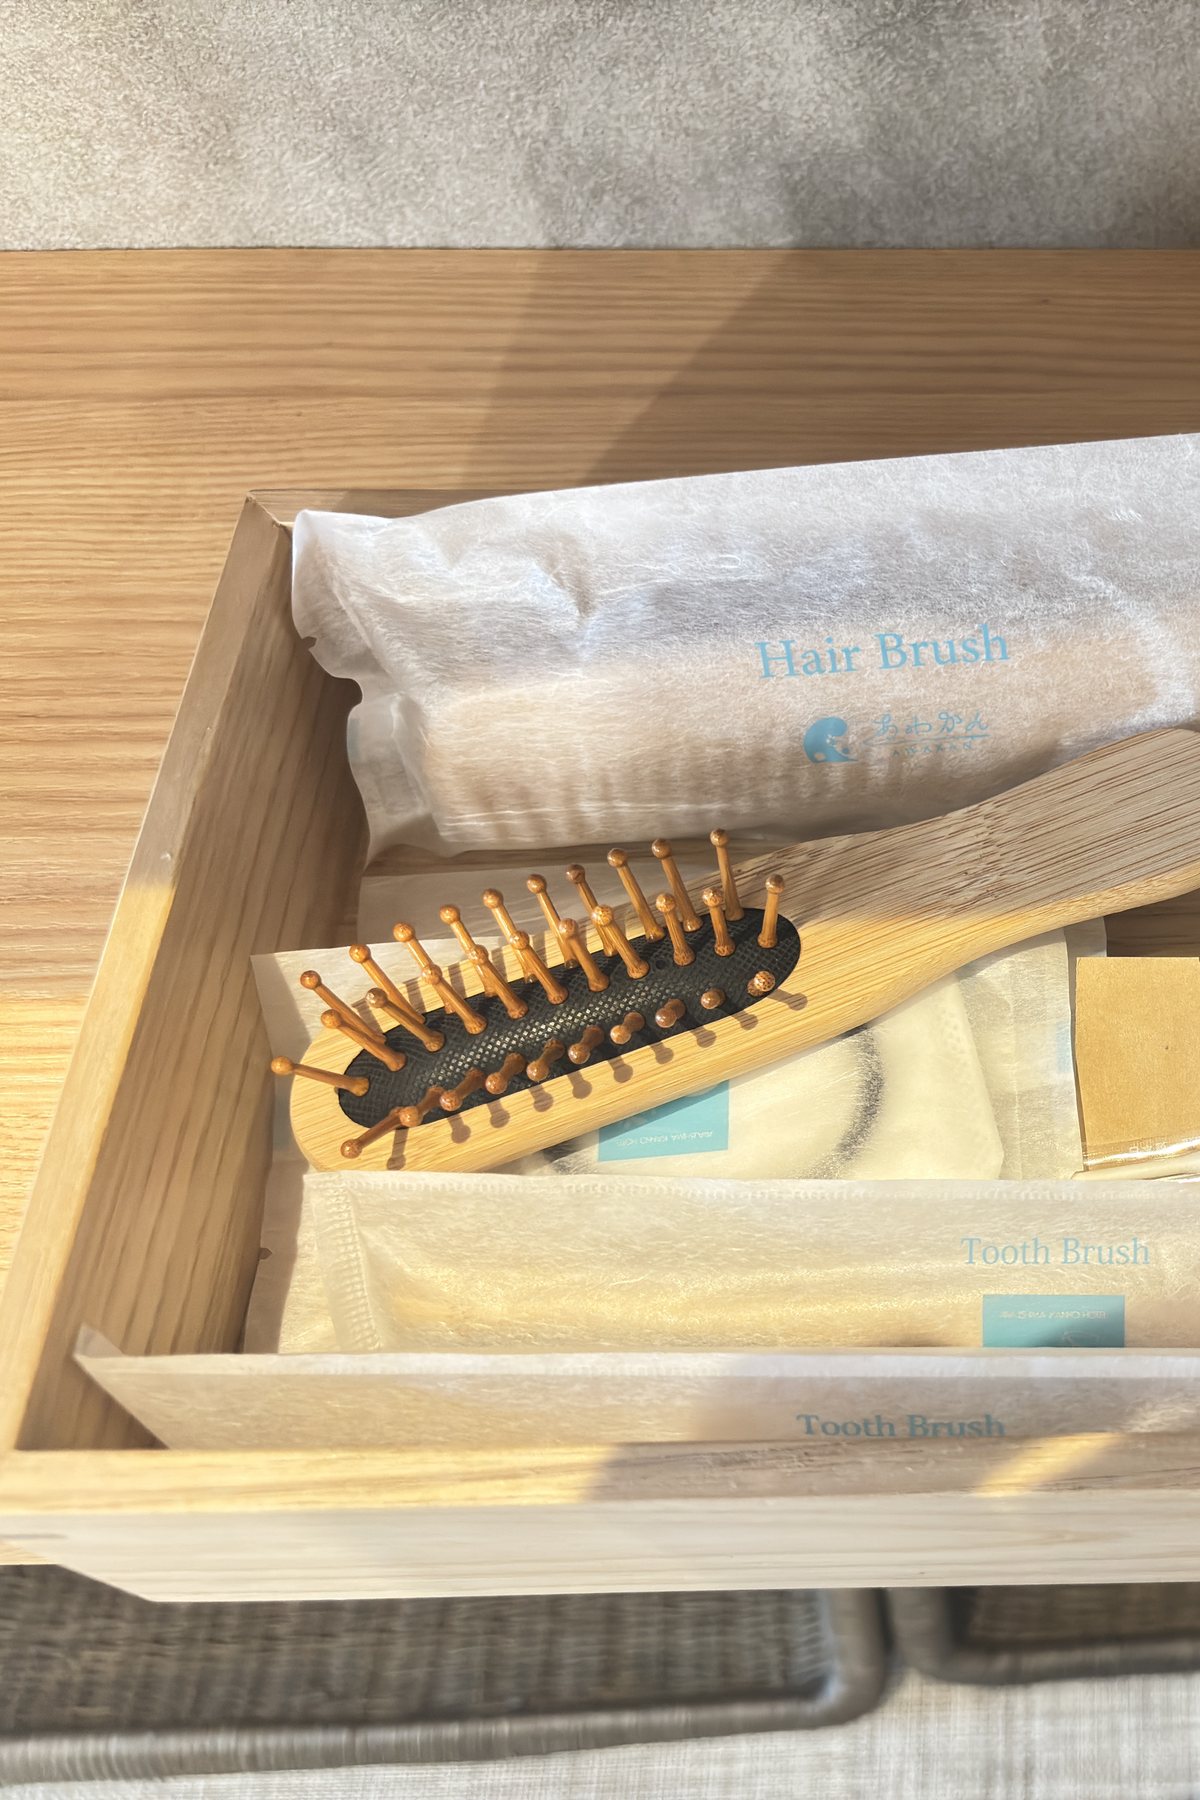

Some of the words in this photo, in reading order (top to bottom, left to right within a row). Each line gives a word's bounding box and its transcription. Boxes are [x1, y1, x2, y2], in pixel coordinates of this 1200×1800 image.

[754, 636, 861, 680] Hair
[874, 622, 1011, 671] Brush
[959, 1236, 1050, 1265] Tooth
[1061, 1236, 1150, 1265] Brush
[796, 1413, 896, 1438] Tooth
[905, 1412, 1006, 1439] Brush
